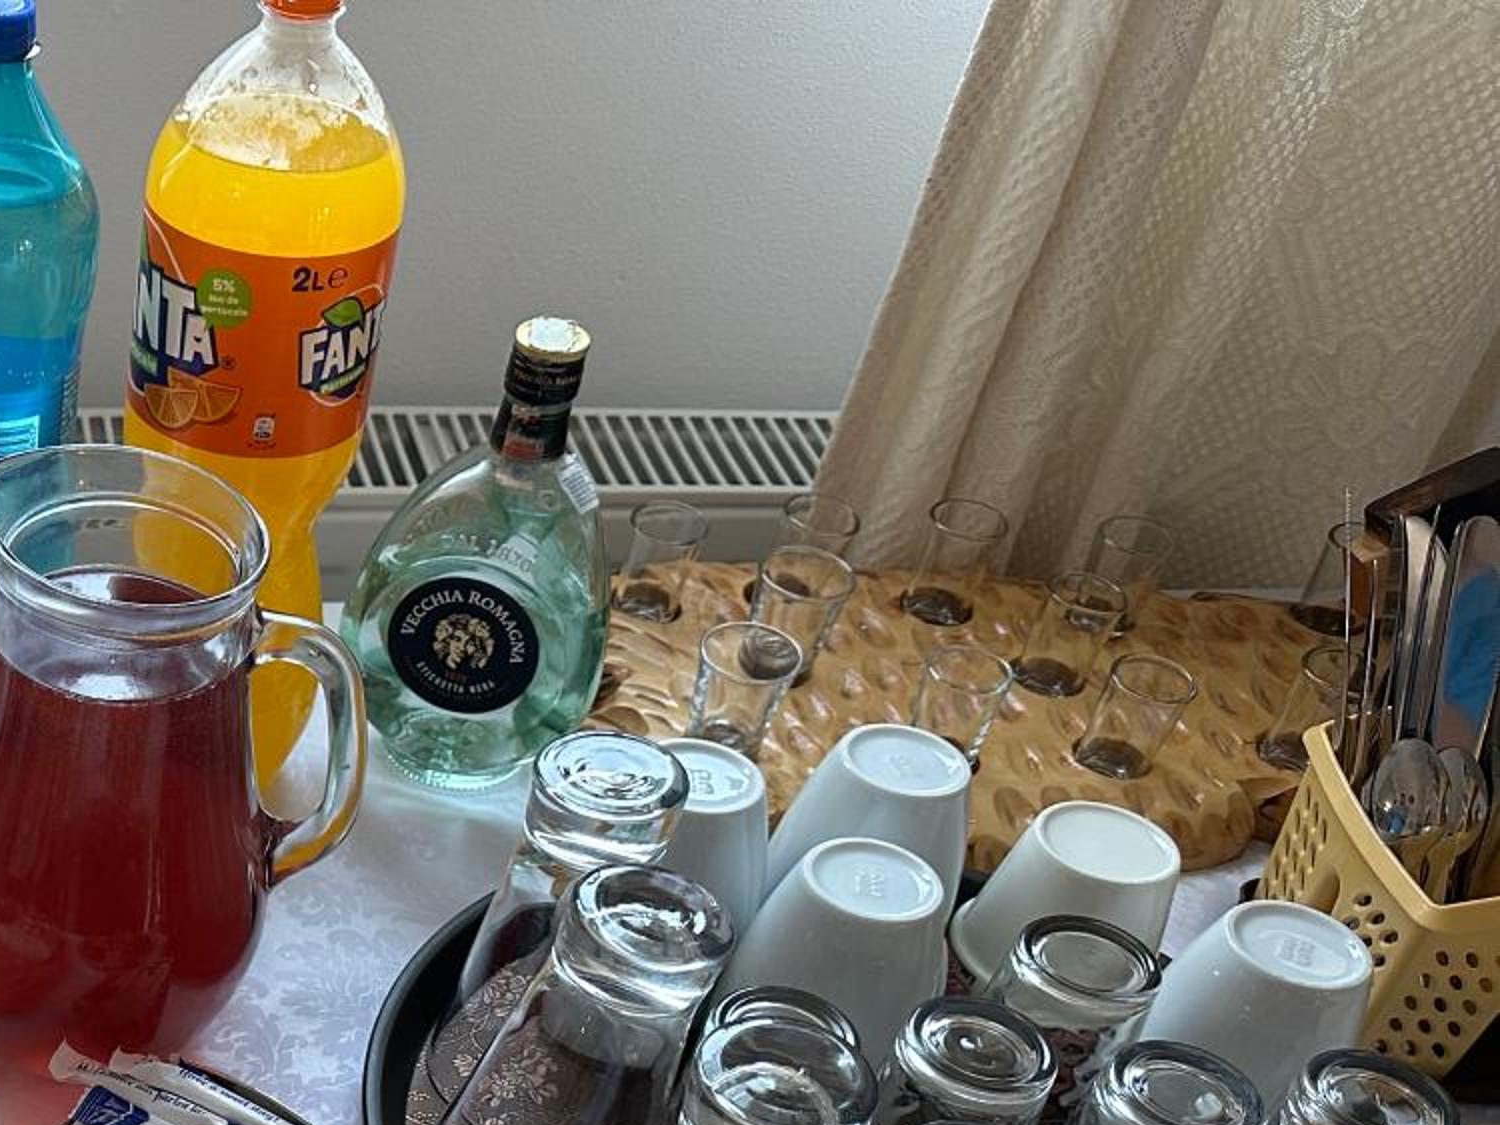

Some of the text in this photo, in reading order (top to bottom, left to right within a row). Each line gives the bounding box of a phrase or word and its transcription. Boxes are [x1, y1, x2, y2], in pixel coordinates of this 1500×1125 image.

[133, 265, 216, 366] NTA
[400, 589, 526, 664] VECCHIA ROMAGNA
